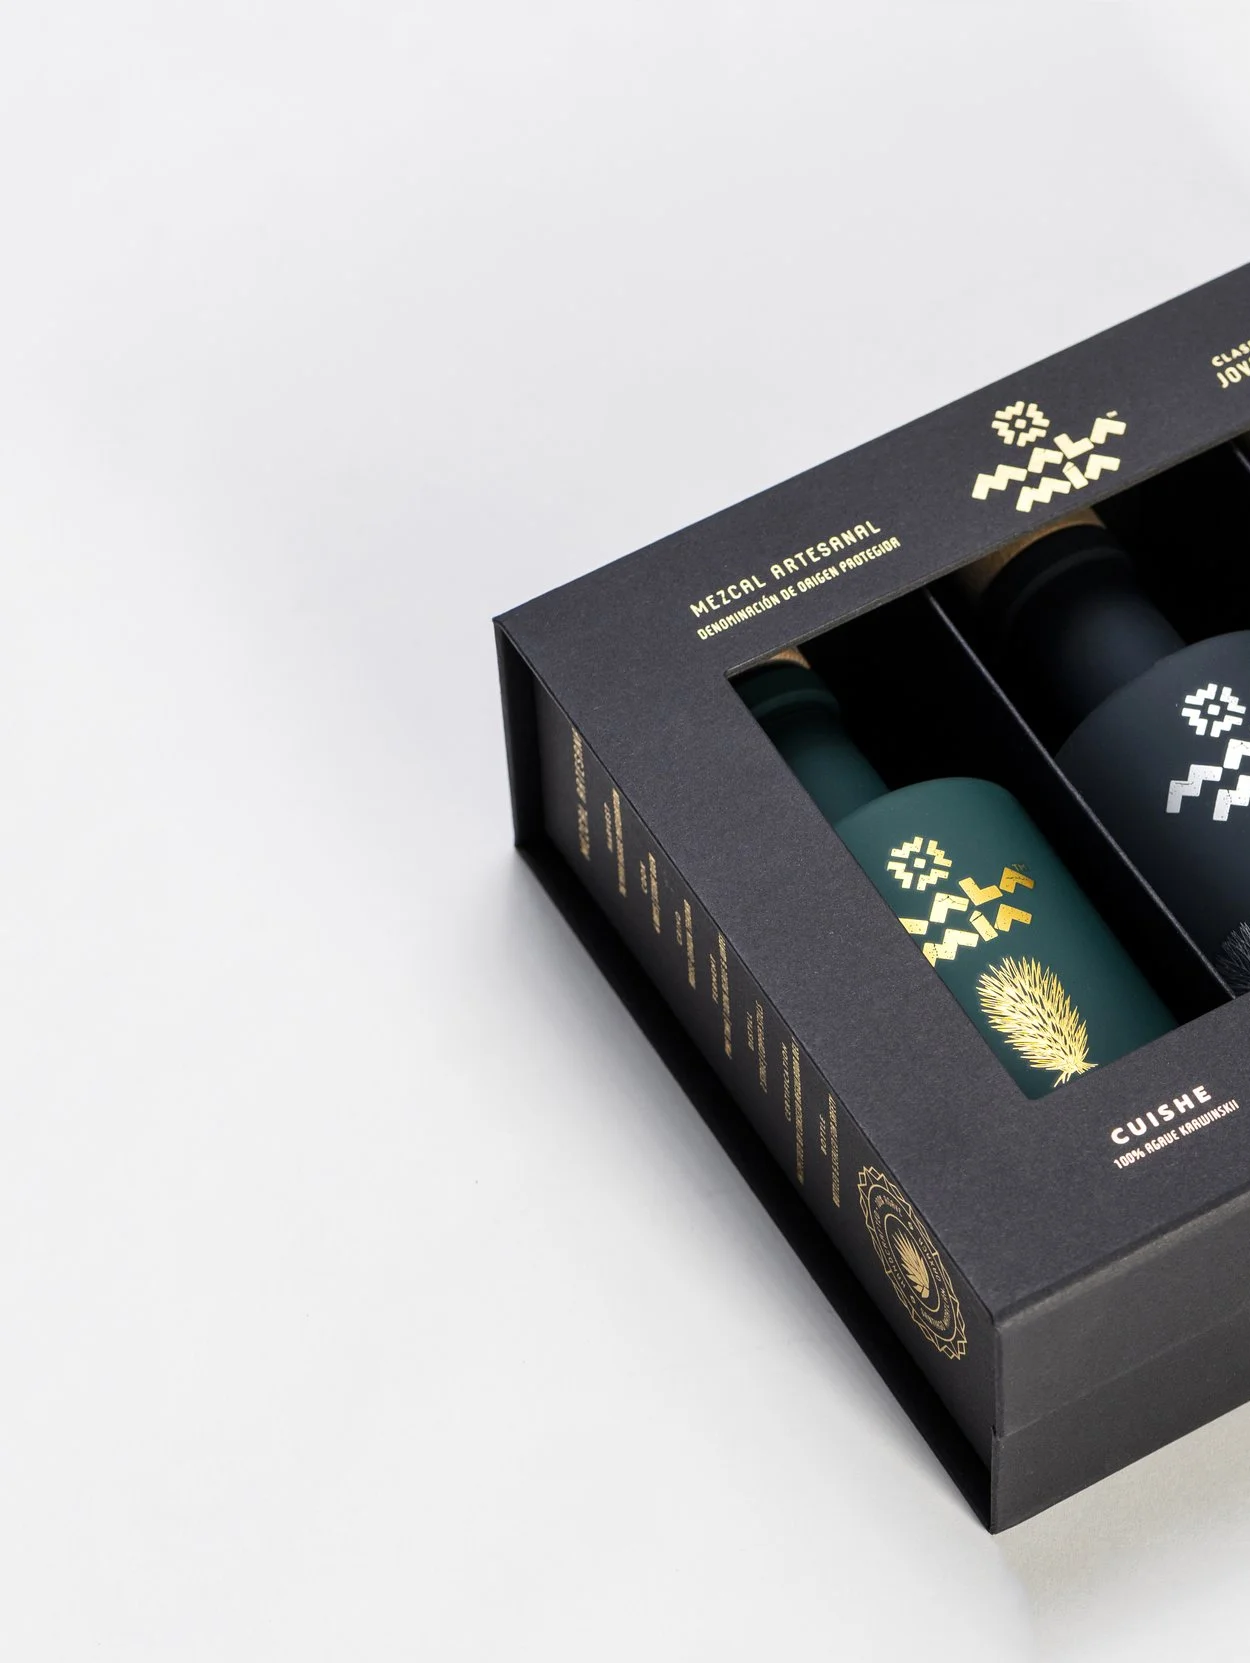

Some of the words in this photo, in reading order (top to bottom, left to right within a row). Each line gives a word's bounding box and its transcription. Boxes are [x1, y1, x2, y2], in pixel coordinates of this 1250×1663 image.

[690, 576, 766, 617] MEZCAL
[770, 521, 880, 579] ARTESANAL
[697, 594, 780, 640] DENOMINACIÓN
[780, 585, 798, 601] DE
[798, 566, 839, 592] ORIGEN
[839, 537, 900, 572] PROTEGIDA
[782, 1042, 791, 1121] CERTIFICATION
[1111, 1086, 1211, 1144] CUISHE
[819, 1114, 828, 1156] BOTTLE
[1114, 1148, 1146, 1169] 100%
[1178, 1100, 1239, 1136] KARWINSKII
